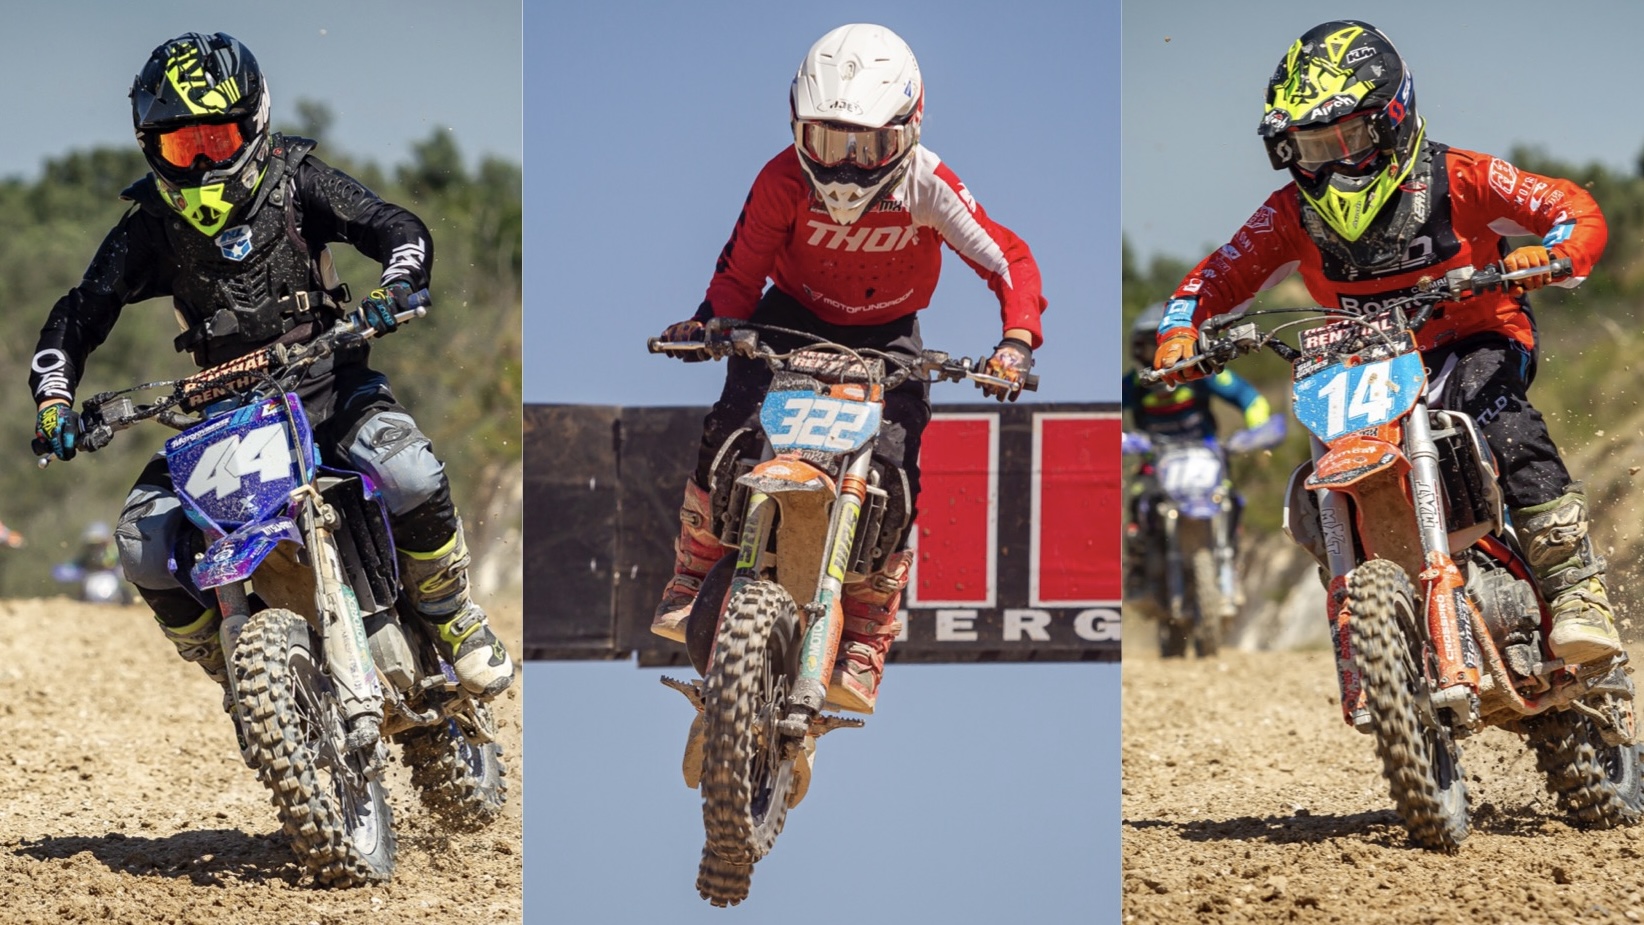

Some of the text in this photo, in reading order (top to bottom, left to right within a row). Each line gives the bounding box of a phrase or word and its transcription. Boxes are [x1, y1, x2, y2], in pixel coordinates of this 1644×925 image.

[1347, 47, 1376, 63] KTM
[1311, 95, 1356, 119] Airoh
[1318, 361, 1394, 437] 14
[1477, 395, 1508, 426] TLD
[769, 397, 871, 452] 322
[184, 421, 292, 500] 44
